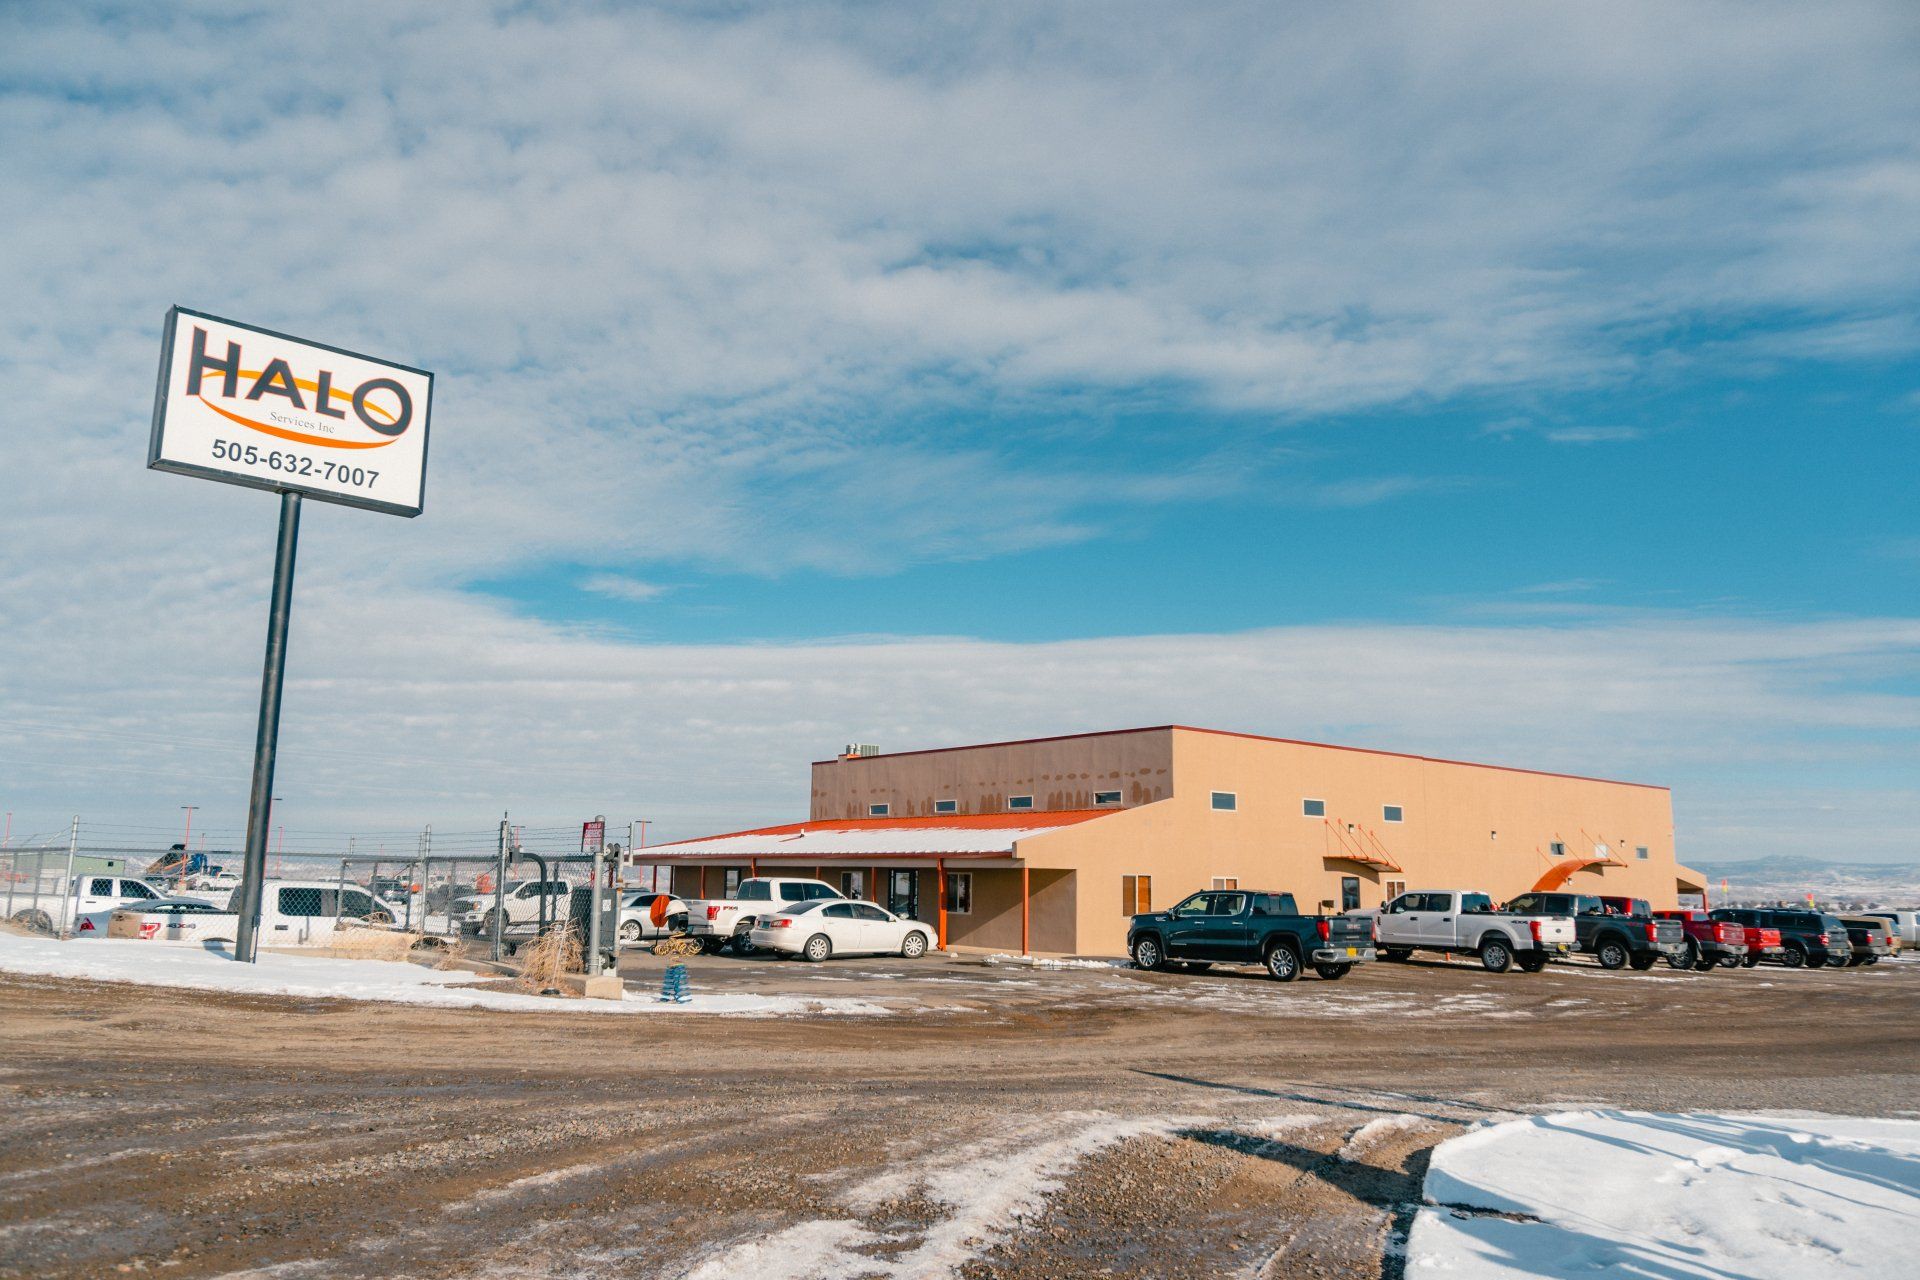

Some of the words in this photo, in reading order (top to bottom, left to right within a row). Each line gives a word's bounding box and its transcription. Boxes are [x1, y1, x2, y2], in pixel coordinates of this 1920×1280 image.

[186, 325, 413, 437] HALO
[269, 411, 315, 430] Services
[318, 421, 336, 434] Inc
[212, 438, 380, 489] 505-632-7007
